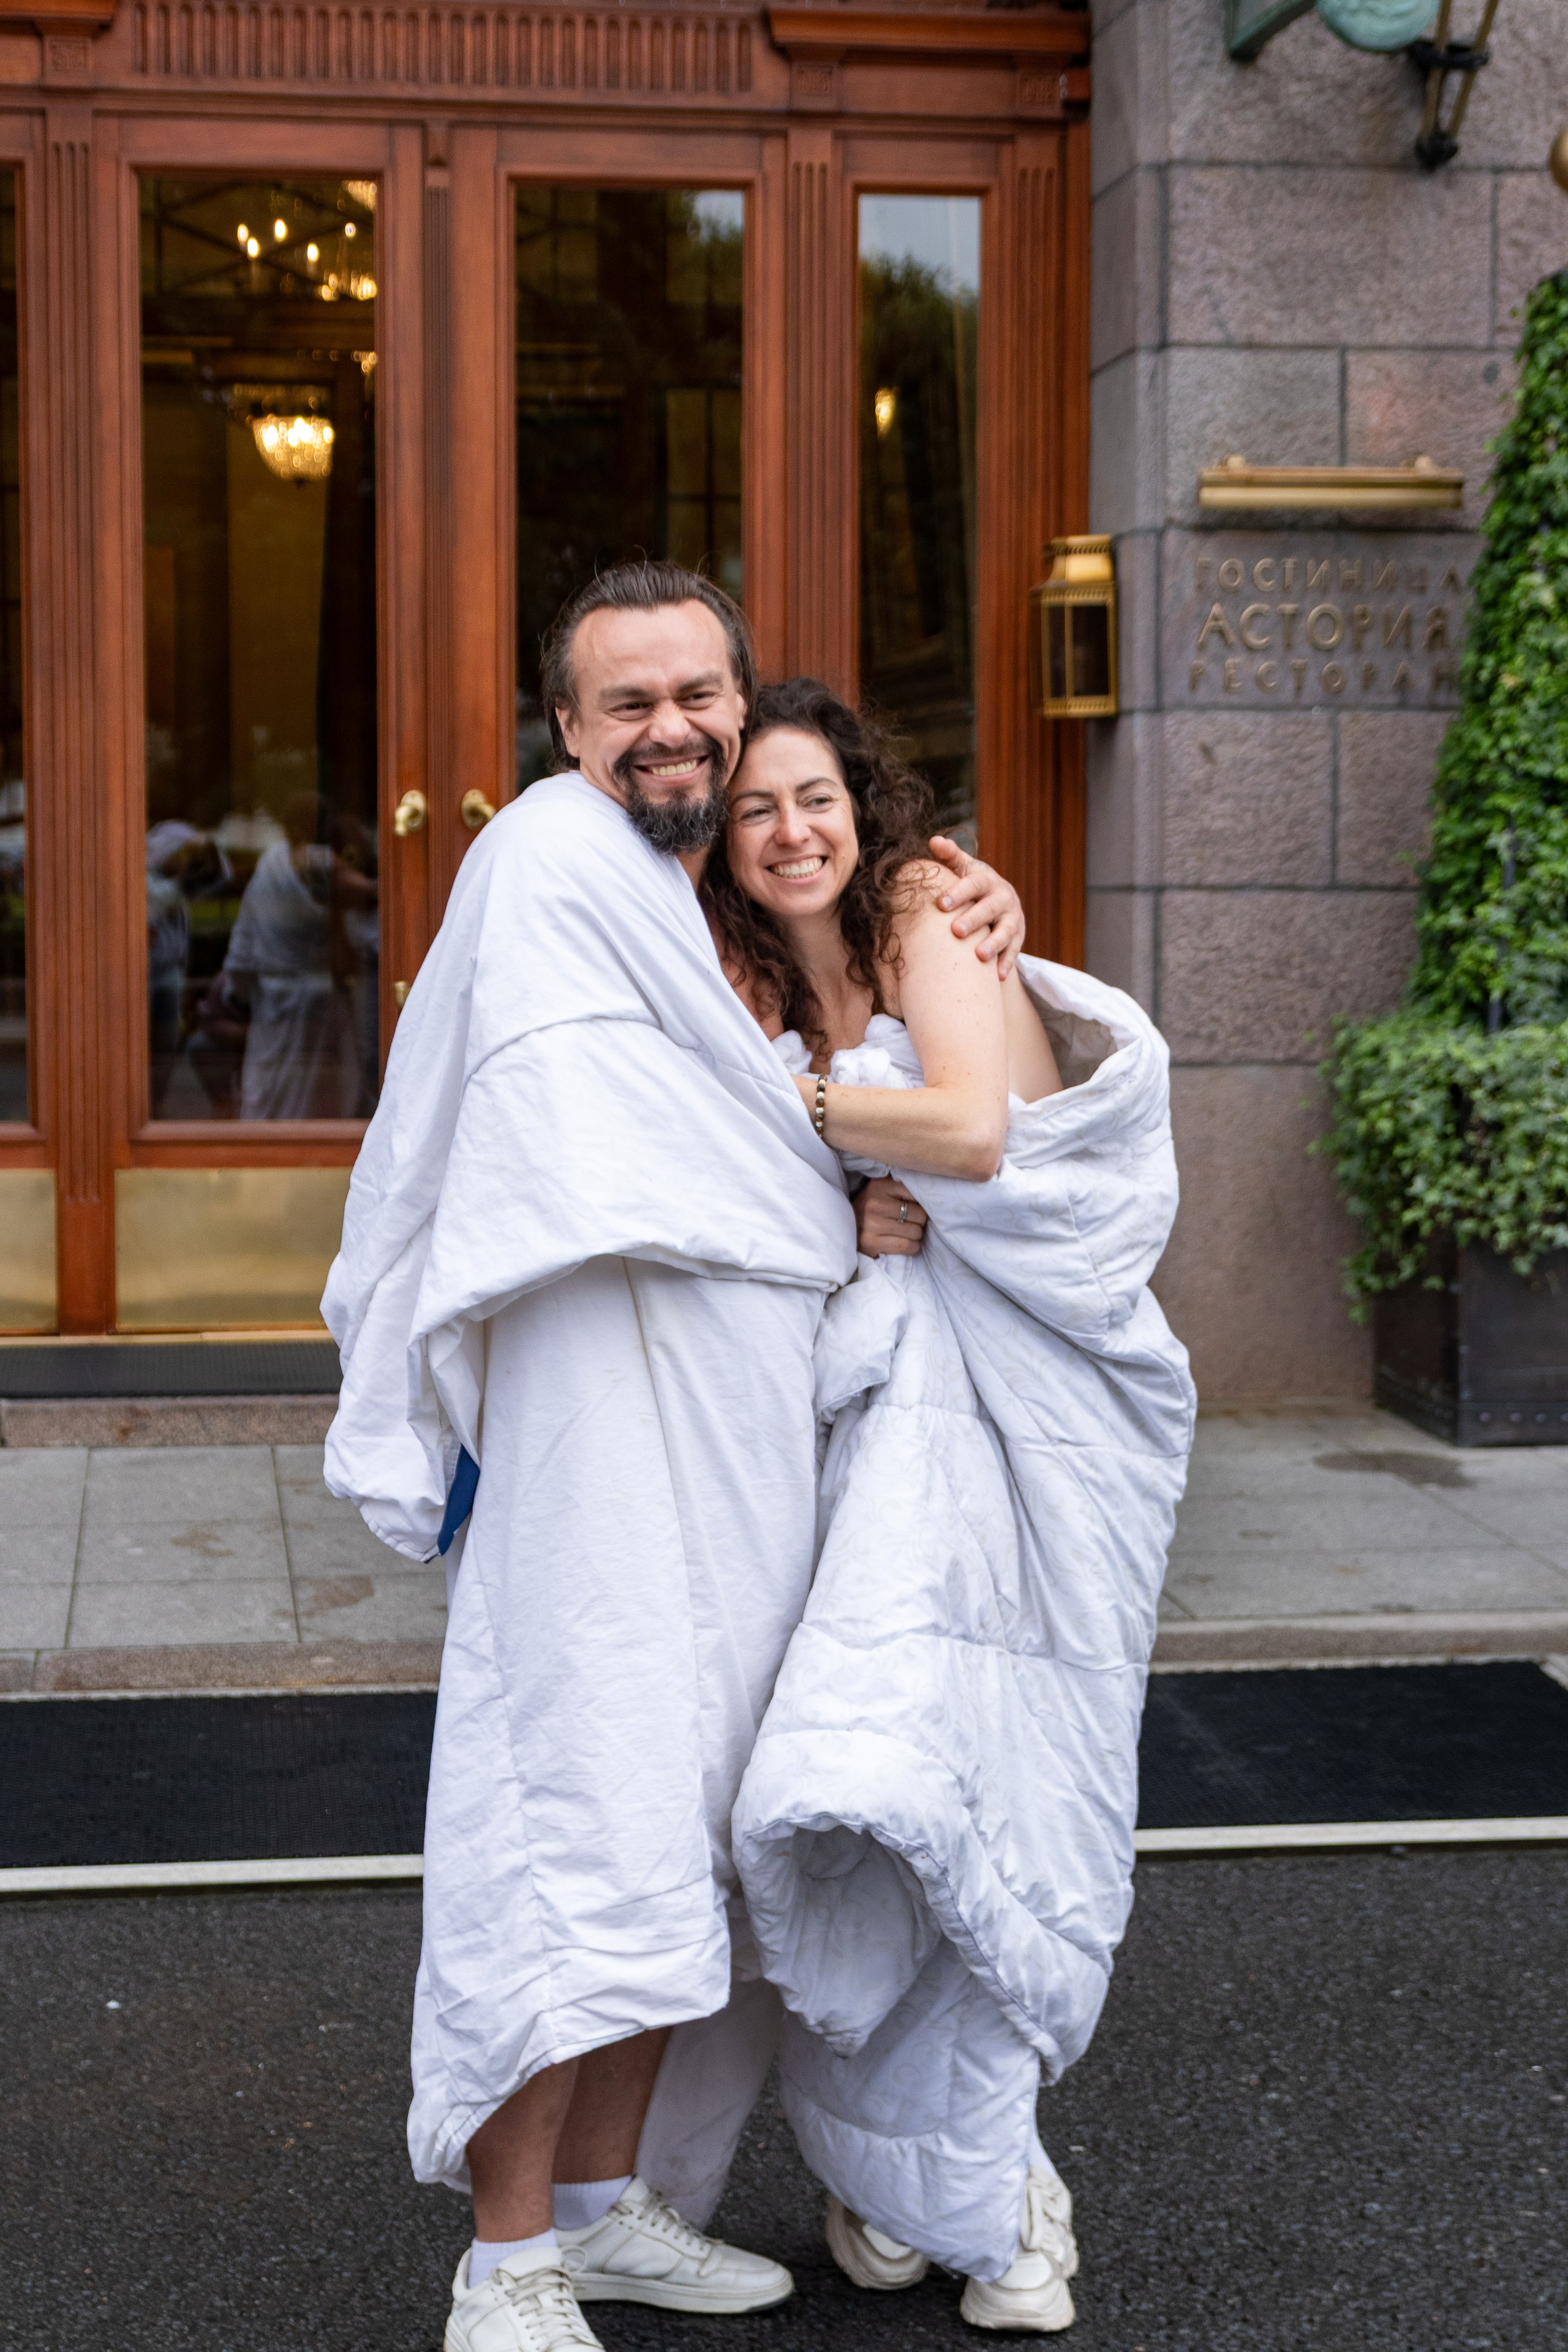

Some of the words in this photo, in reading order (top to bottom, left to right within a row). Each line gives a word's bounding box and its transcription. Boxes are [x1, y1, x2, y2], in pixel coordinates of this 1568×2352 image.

[1194, 557, 1461, 592] ГОСТИНИЦА
[1196, 603, 1449, 650] АСТОРИЯ
[1189, 659, 1456, 695] РЕСТОРАН
